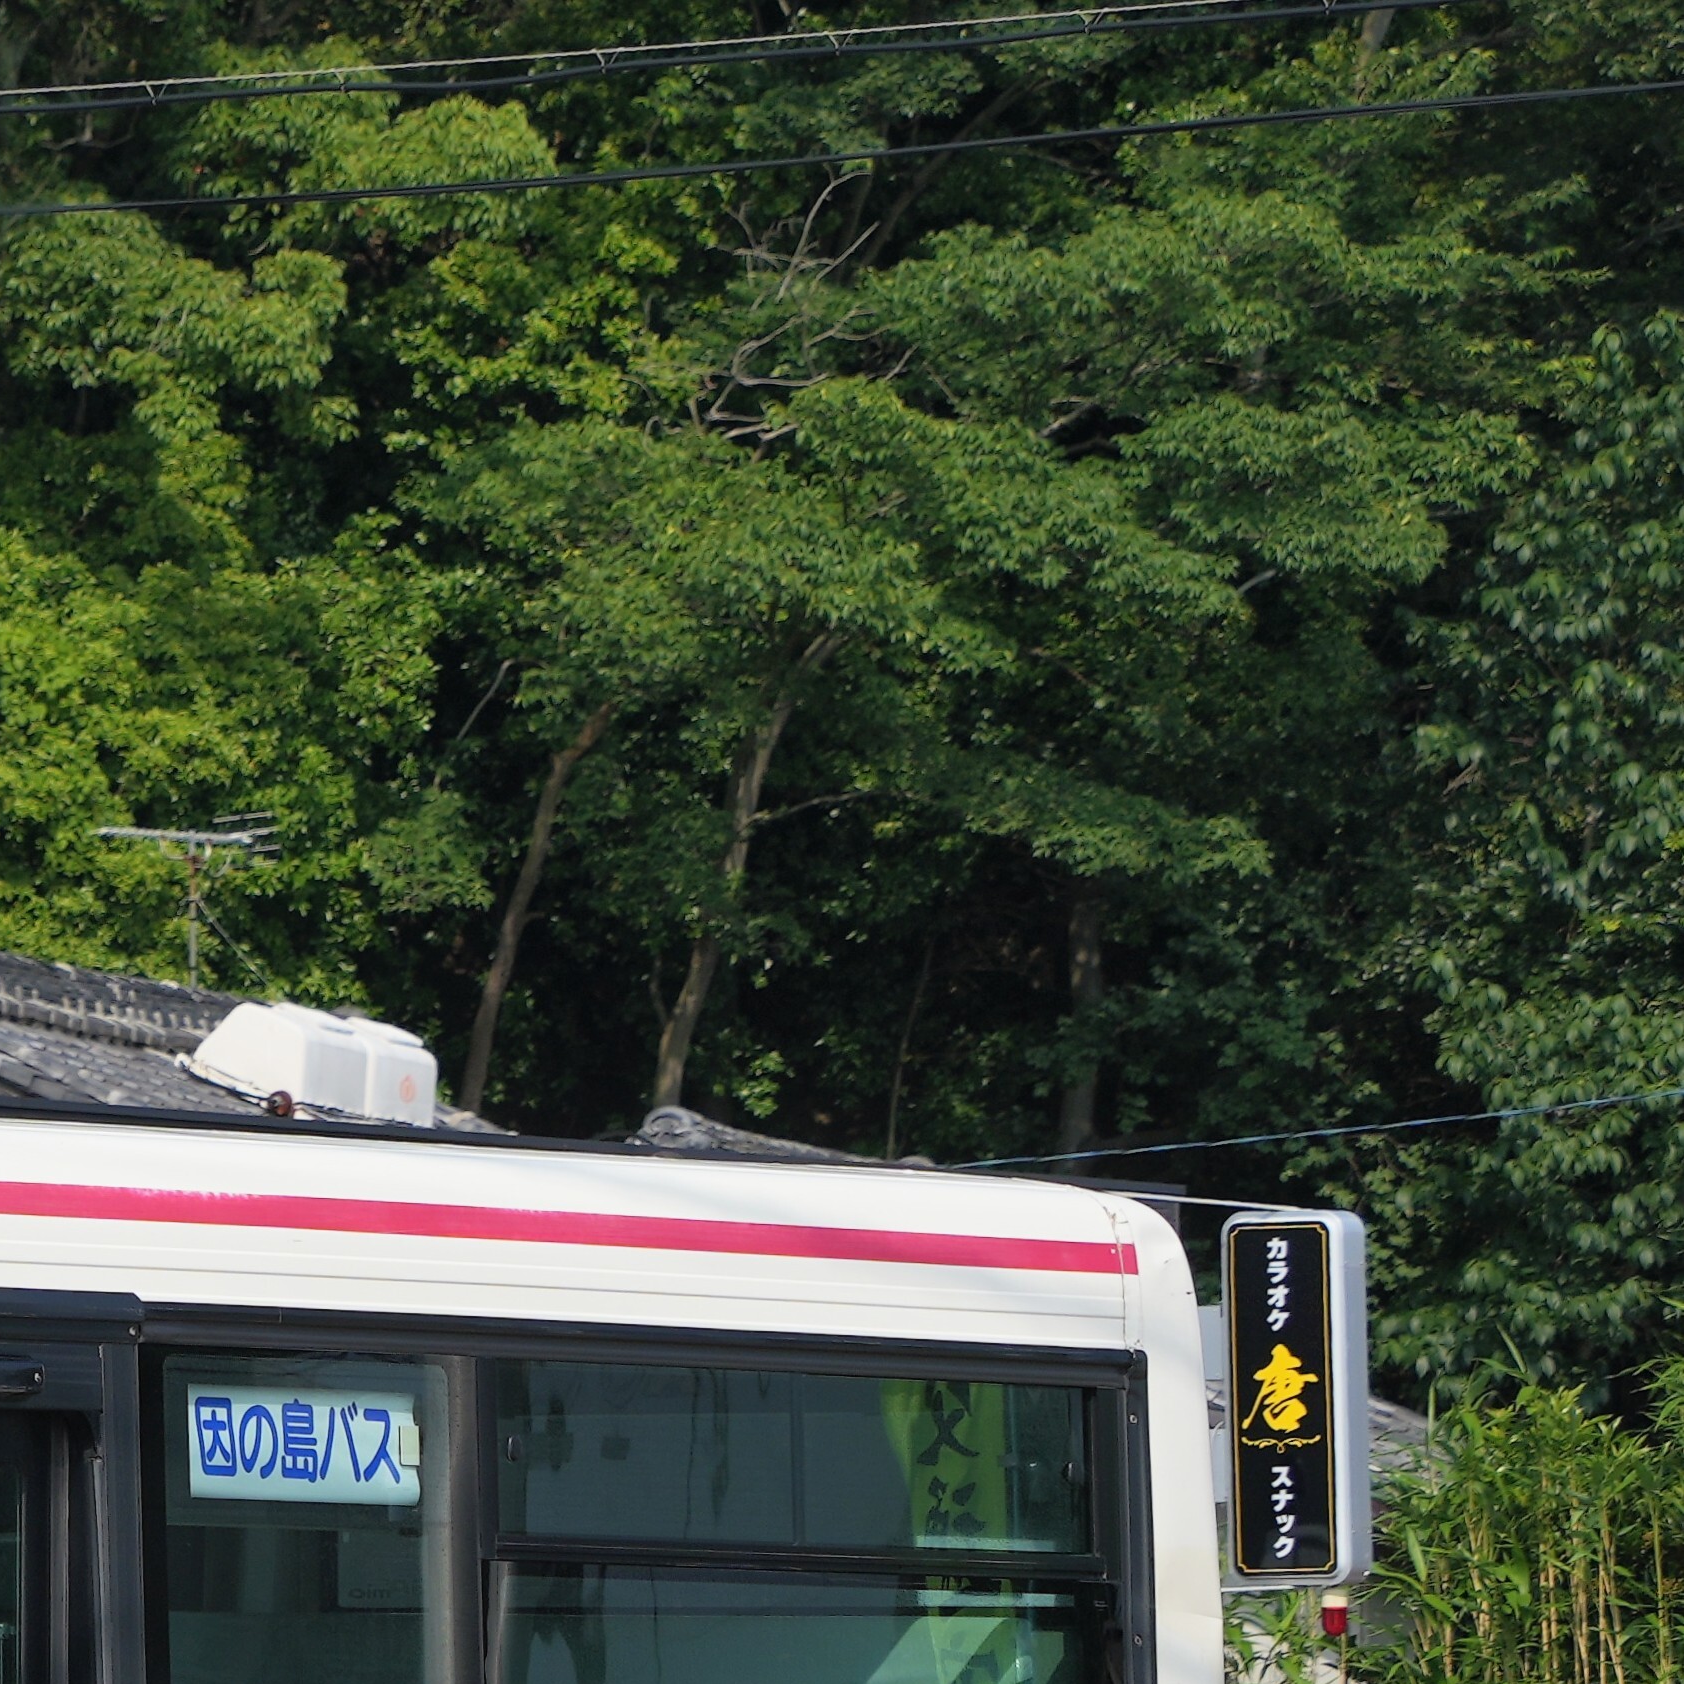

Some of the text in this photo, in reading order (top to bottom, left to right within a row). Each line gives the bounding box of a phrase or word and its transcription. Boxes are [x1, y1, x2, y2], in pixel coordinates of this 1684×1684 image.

[1266, 1237, 1292, 1333] カラオケ
[1241, 1343, 1319, 1434] 唐
[193, 1396, 402, 1485] 因の島バス
[1270, 1465, 1296, 1560] スナック
